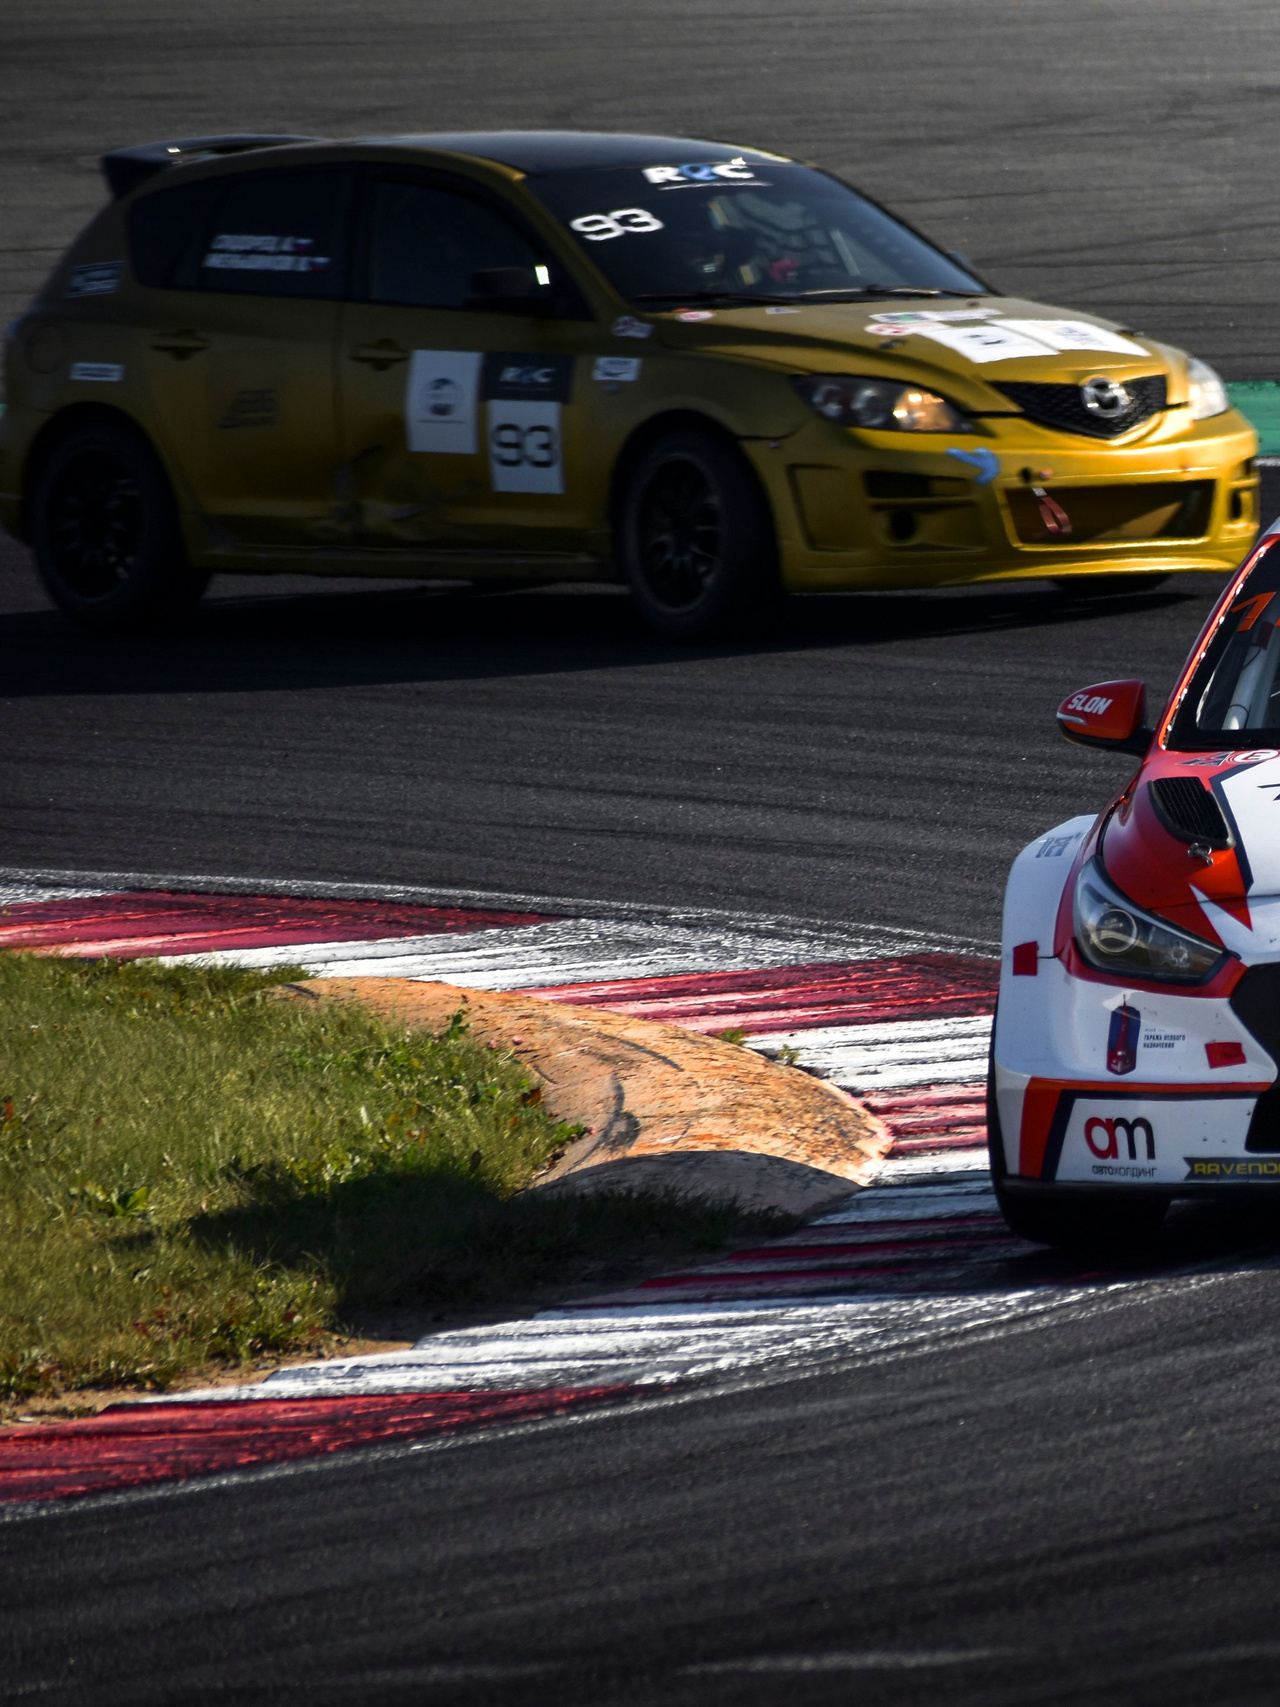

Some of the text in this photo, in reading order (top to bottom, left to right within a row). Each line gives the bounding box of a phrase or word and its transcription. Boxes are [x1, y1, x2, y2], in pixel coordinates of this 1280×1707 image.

[570, 207, 664, 241] 93
[491, 423, 559, 469] 93
[1067, 694, 1114, 716] SLON
